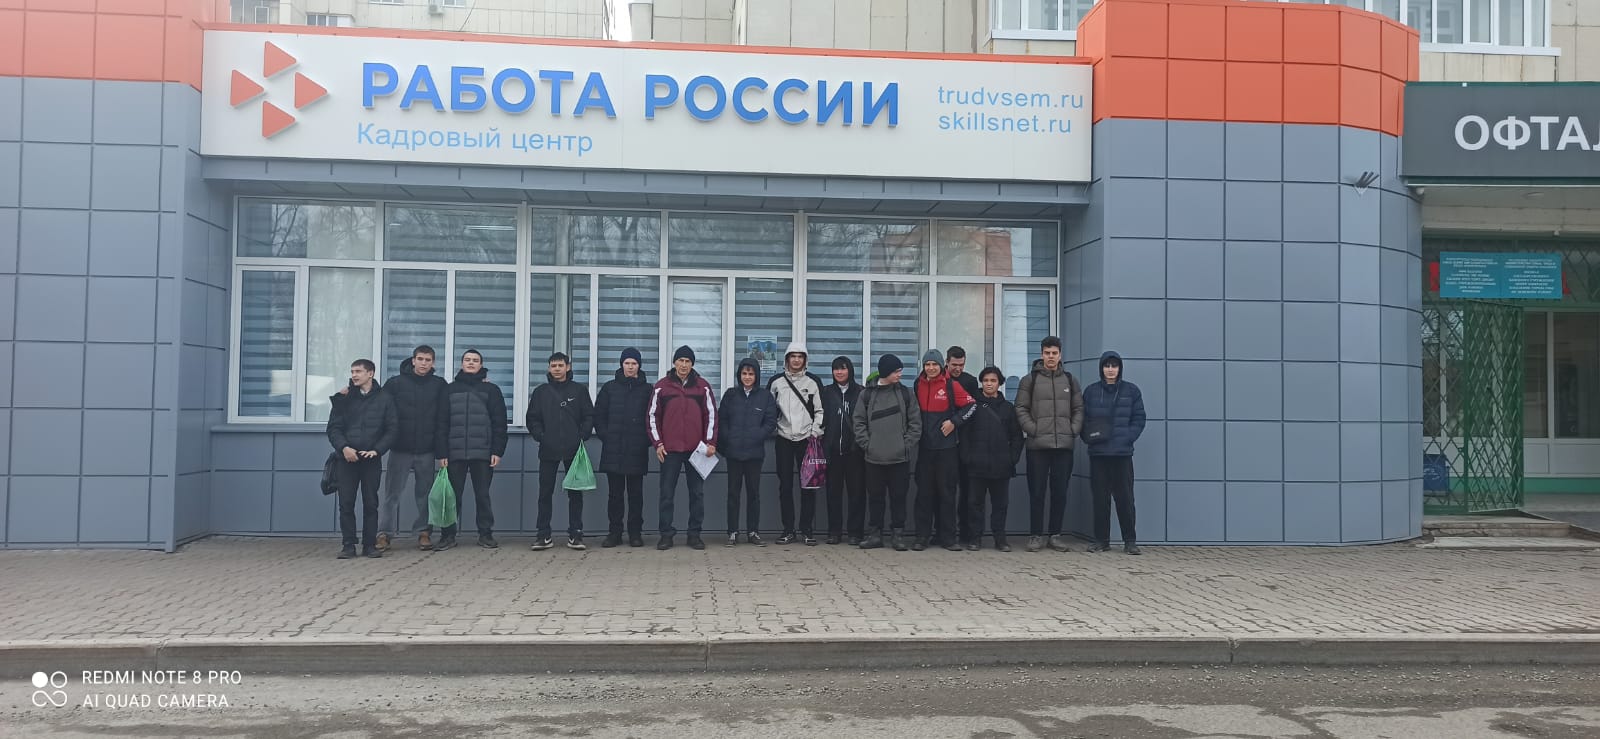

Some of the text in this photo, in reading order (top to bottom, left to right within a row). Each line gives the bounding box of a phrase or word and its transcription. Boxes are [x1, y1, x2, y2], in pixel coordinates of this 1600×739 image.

[362, 62, 899, 127] РАБОТА РОССИИ
[937, 85, 1084, 109] trudvsem.ru
[357, 122, 593, 157] Кадровый центр
[938, 111, 1072, 134] skillsnet.ru
[1454, 115, 1600, 152] ОФТА
